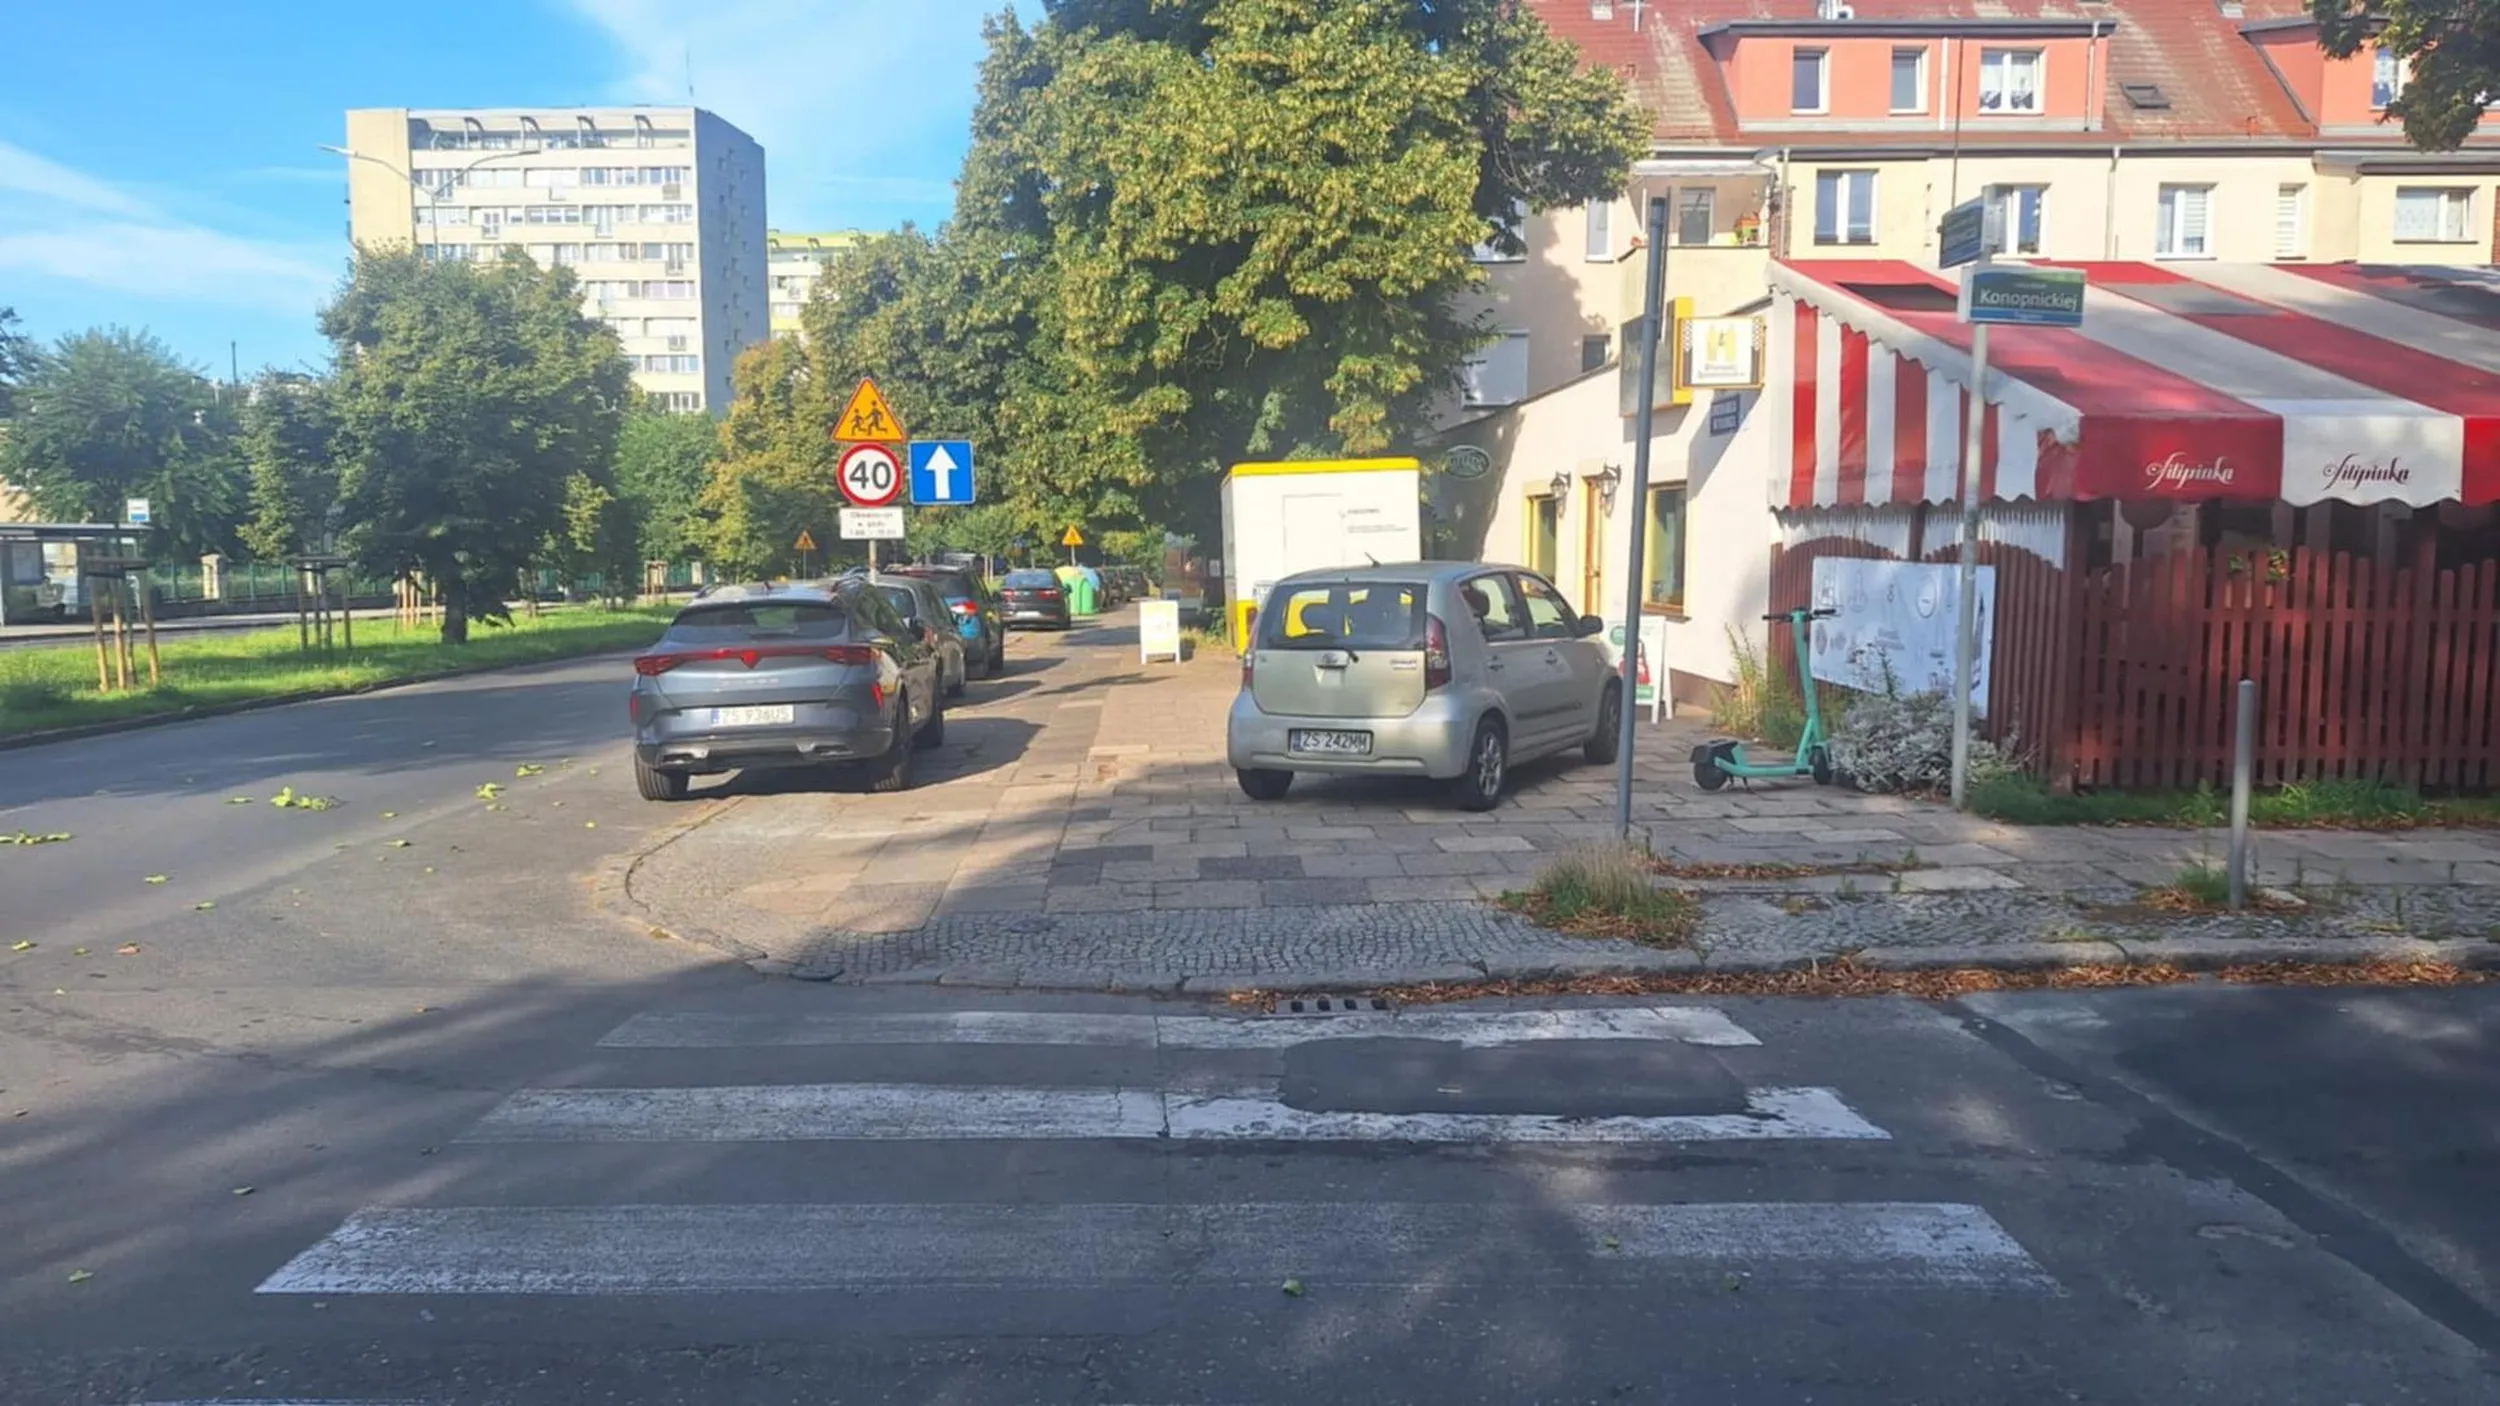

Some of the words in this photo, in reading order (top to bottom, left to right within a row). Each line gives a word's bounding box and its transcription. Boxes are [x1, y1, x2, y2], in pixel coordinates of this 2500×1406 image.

[1980, 289, 2078, 312] Konopnickiej
[849, 460, 892, 489] 40
[1303, 731, 1320, 747] ZS
